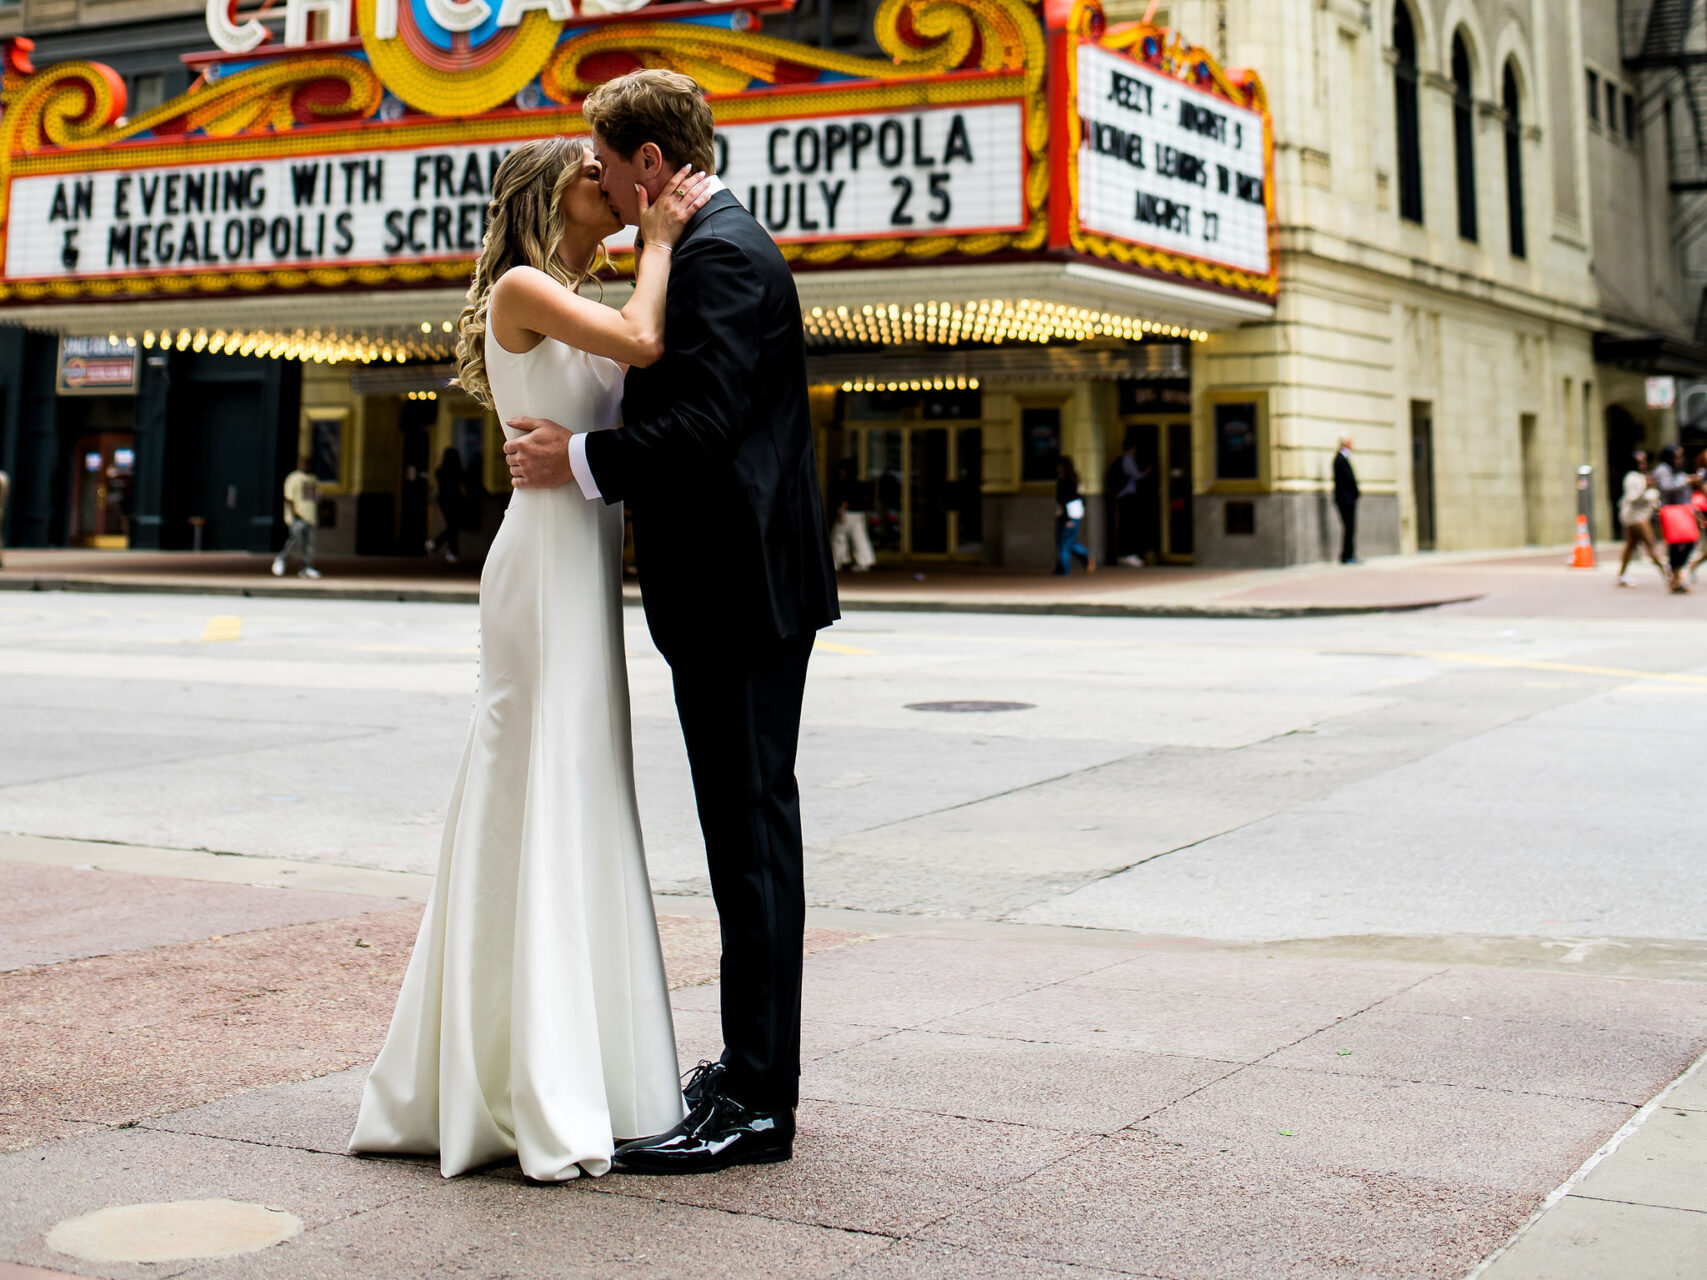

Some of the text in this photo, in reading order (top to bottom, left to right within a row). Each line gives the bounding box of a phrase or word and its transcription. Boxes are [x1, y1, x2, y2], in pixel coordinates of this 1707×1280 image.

[50, 177, 94, 222] AN
[115, 167, 266, 220] EVENING
[290, 157, 384, 208] WITH
[768, 114, 974, 176] COPPOLA
[107, 211, 355, 267] MEGALOPOLIS
[890, 172, 952, 226] 25
